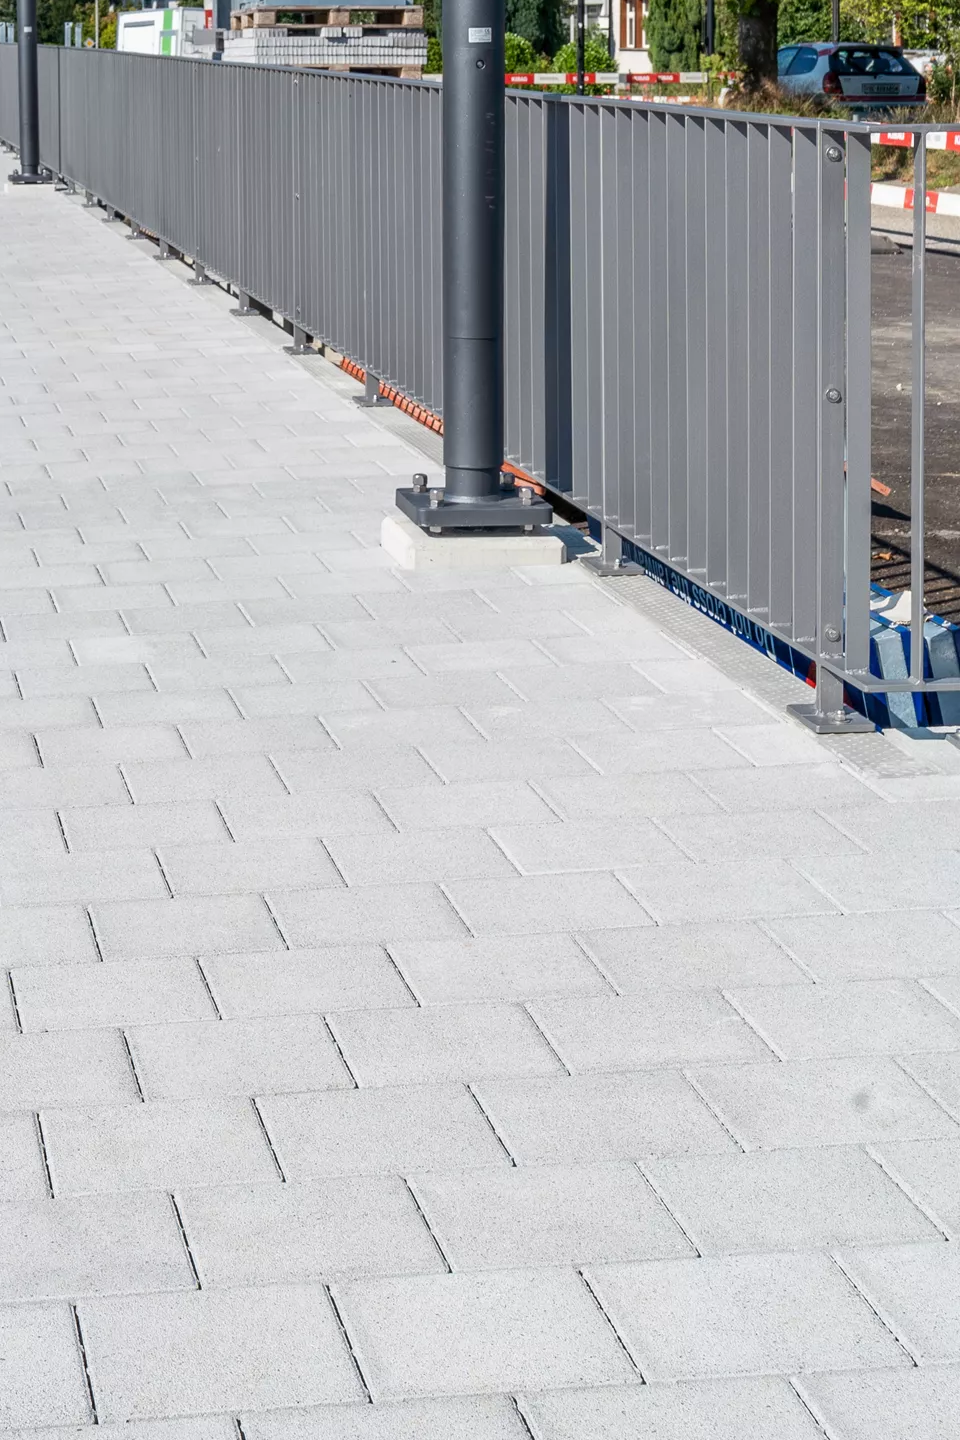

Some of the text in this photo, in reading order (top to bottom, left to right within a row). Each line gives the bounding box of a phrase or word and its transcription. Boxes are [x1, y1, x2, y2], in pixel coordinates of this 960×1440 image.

[670, 572, 692, 607] the
[691, 584, 727, 625] cross
[728, 608, 752, 640] not
[754, 624, 778, 662] Do
